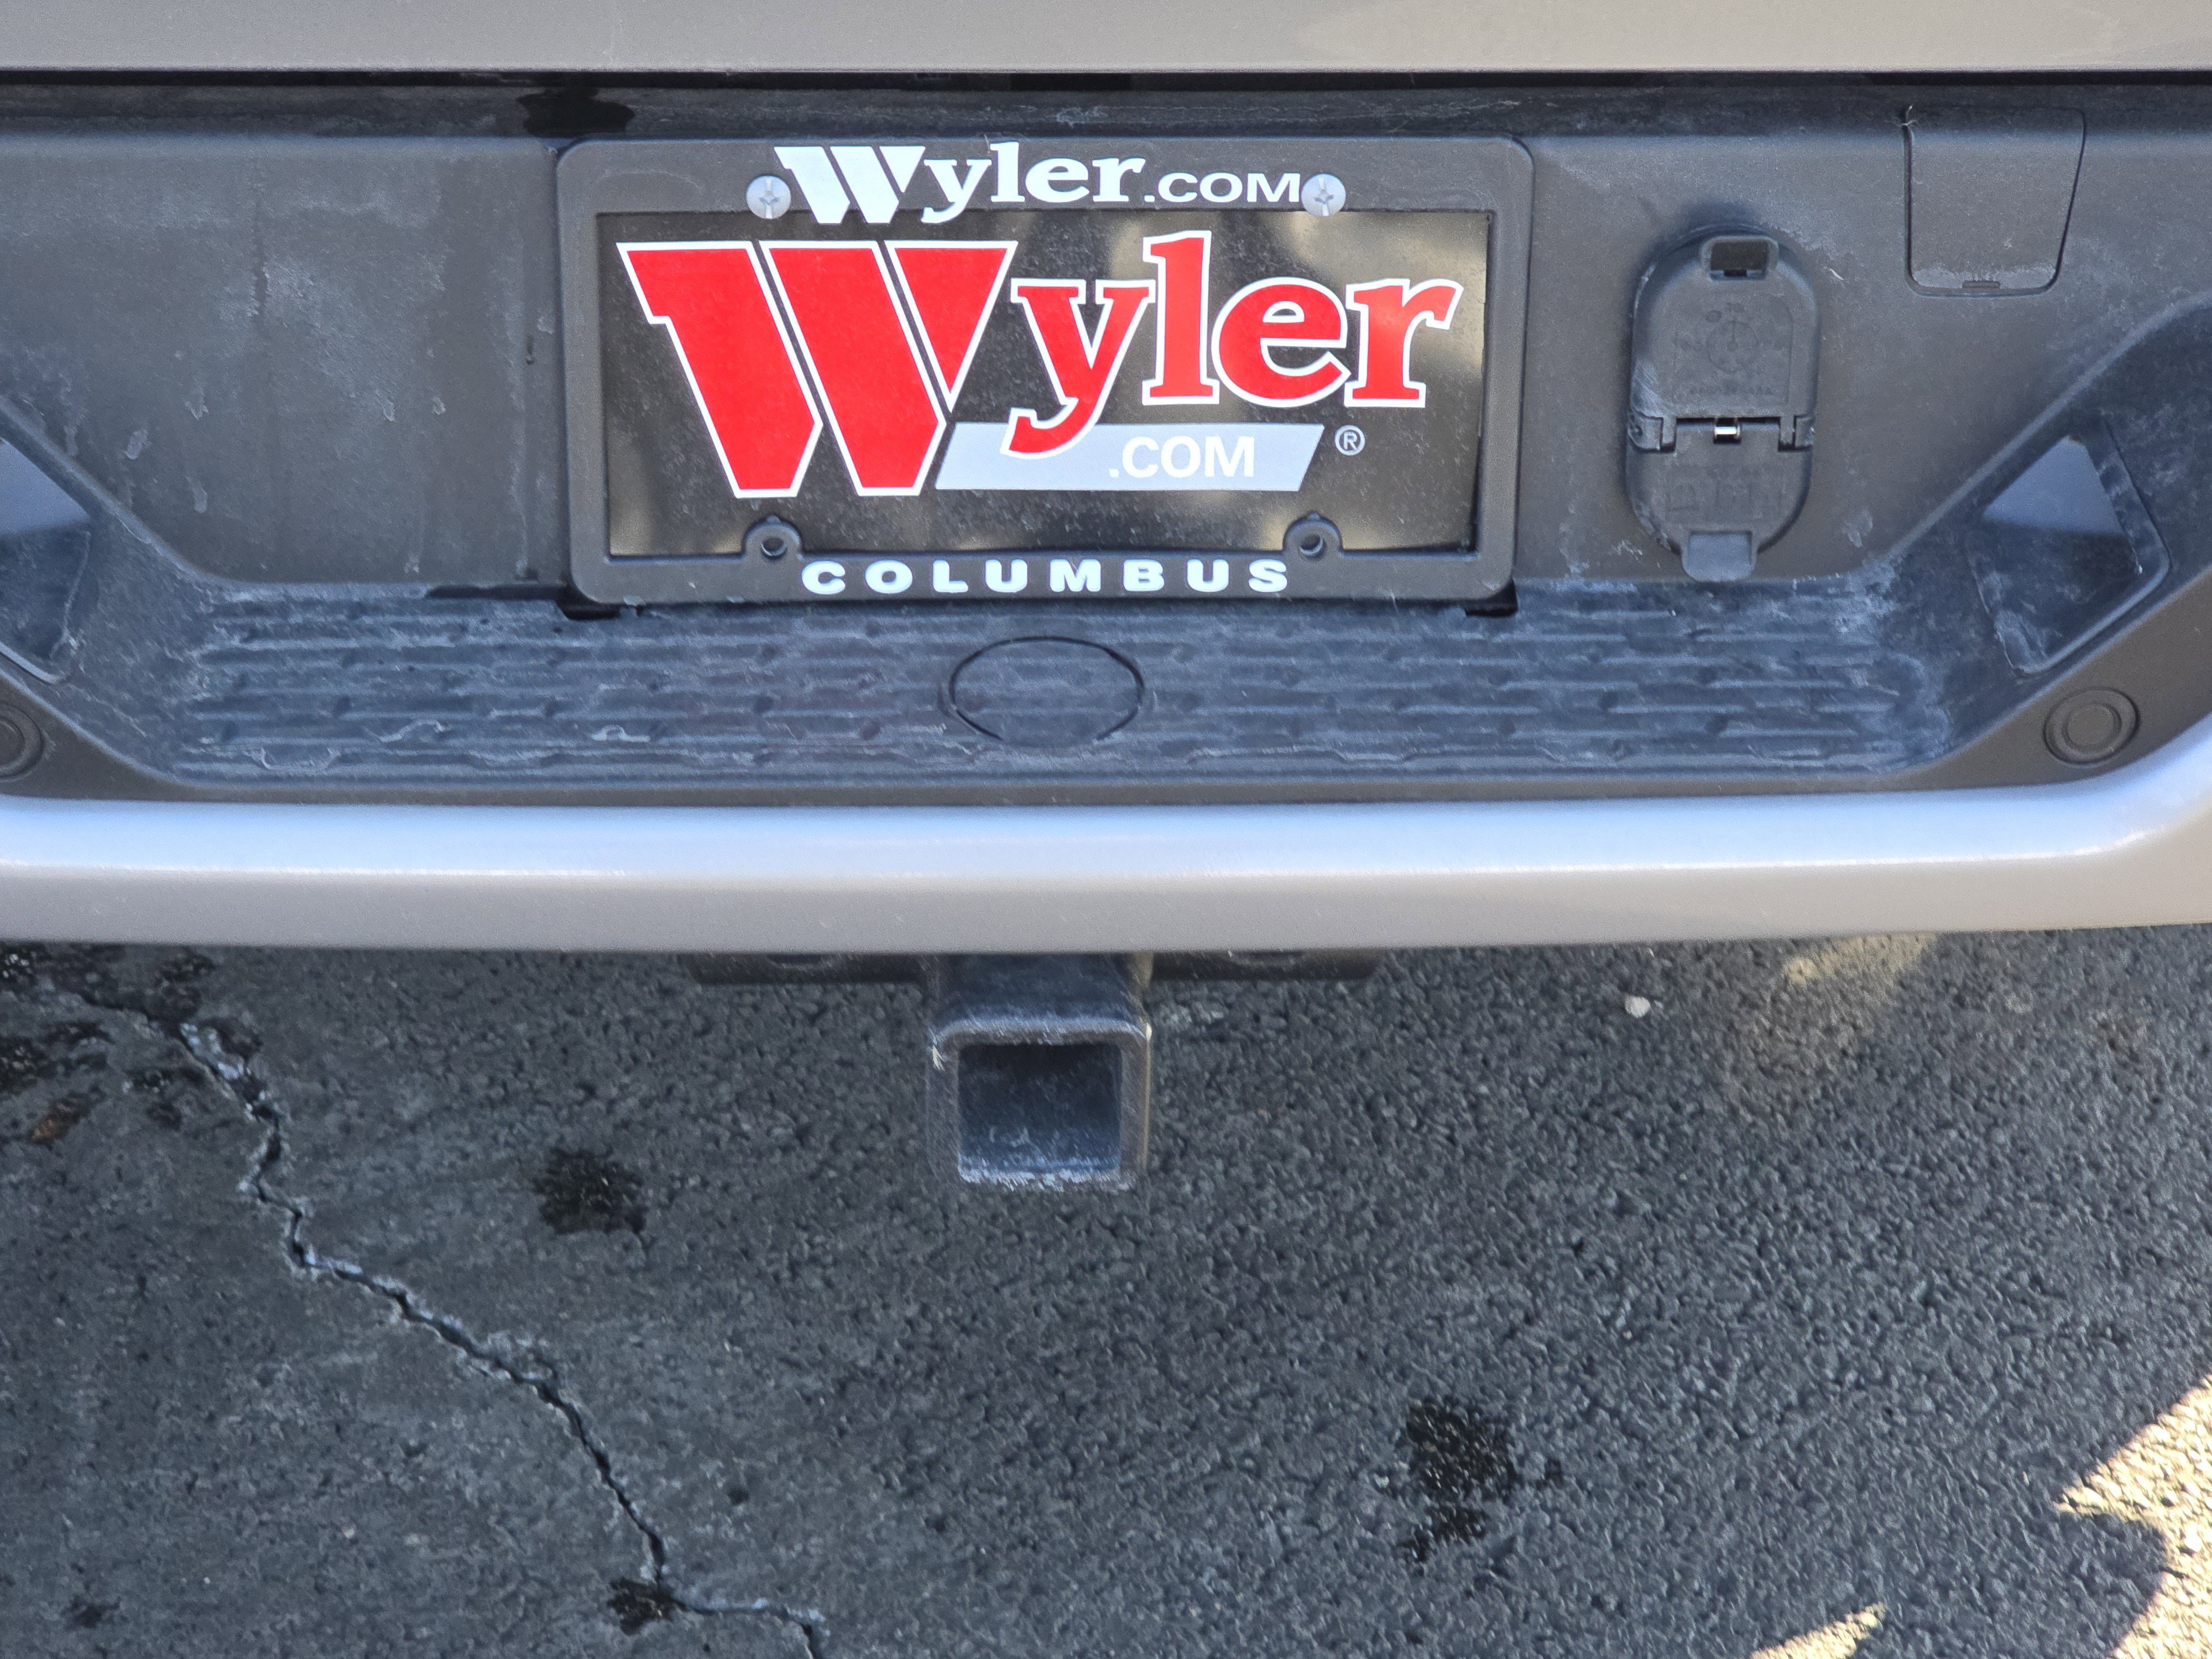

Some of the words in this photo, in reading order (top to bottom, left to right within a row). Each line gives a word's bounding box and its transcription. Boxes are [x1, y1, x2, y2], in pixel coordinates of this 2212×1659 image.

[774, 142, 1300, 224] Wyler.COM
[616, 230, 1463, 498] Wyler
[1109, 436, 1255, 478] .COM
[801, 559, 1287, 594] COLUMBUS
